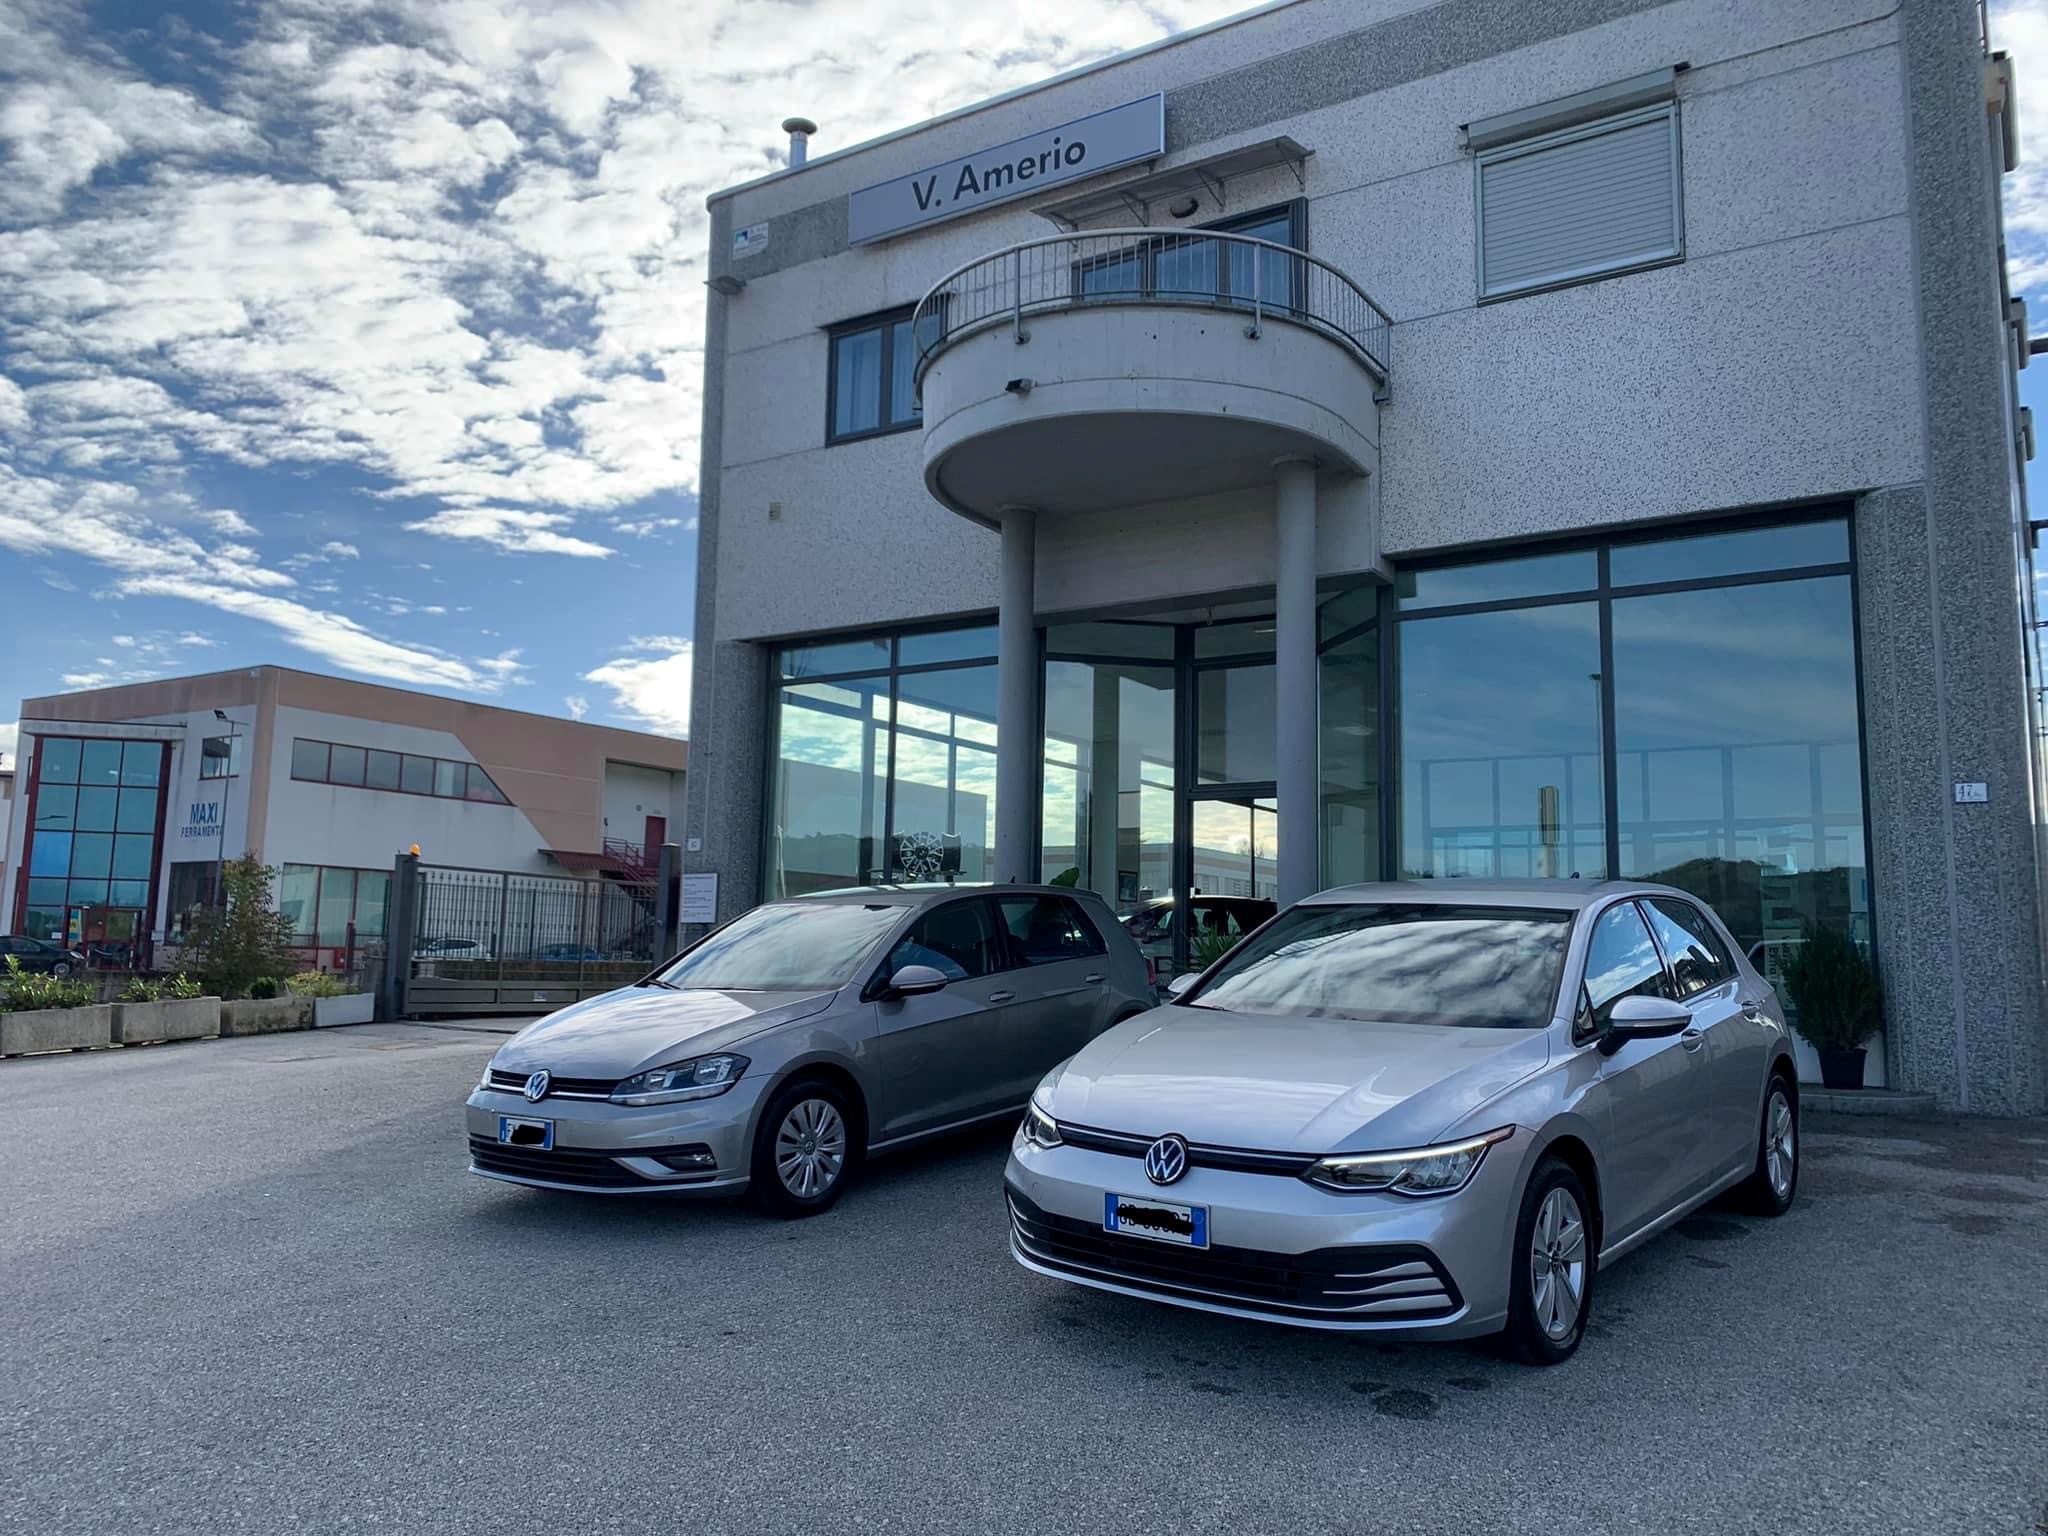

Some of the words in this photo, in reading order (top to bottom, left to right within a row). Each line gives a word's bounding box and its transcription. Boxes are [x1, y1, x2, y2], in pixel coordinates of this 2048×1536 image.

[912, 175, 942, 211] V.
[953, 137, 1086, 200] Amerio
[190, 802, 218, 824] MAXI
[180, 824, 223, 838] FERRAMENT
[1146, 1138, 1185, 1182] VW
